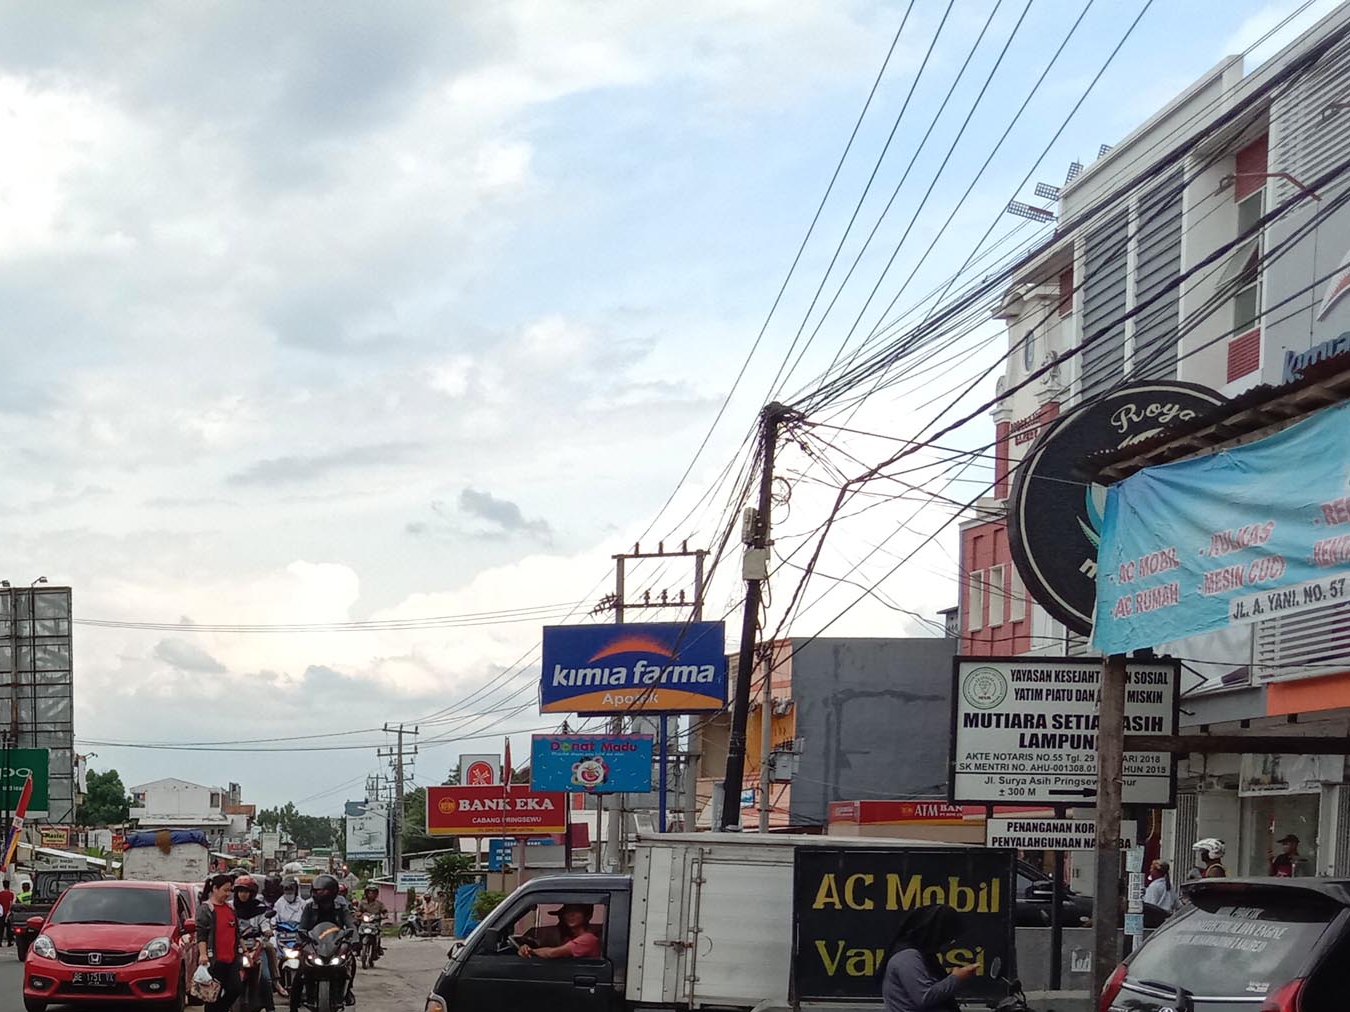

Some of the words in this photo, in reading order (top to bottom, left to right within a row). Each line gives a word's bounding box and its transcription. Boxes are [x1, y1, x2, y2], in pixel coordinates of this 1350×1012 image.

[1203, 565, 1245, 596] MESIN
[1303, 583, 1327, 604] NO.
[552, 664, 627, 687] kimia
[632, 660, 715, 685] farma
[1010, 669, 1052, 683] YAYASAN
[1134, 671, 1169, 685] SOSIAL
[1014, 687, 1044, 702] YATIM
[1045, 688, 1073, 702] PIATU
[1075, 689, 1095, 702] DAN
[1127, 690, 1163, 704] MISKIN
[963, 712, 1048, 729] MUTIARA
[1051, 713, 1100, 731] SETIA
[1122, 715, 1164, 732] ASIH
[600, 741, 638, 752] Madu
[1018, 733, 1099, 751] LAMPUN
[965, 752, 991, 761] AKTE
[992, 752, 1034, 761] NOTARIS
[1084, 754, 1095, 762] 29
[958, 762, 972, 771] SK
[974, 763, 1010, 771] MENTRI
[1012, 763, 1028, 771] NO.
[998, 777, 1027, 788] Surya
[1029, 776, 1051, 785] Asih
[1054, 777, 1098, 788] Pringsew
[1007, 787, 1025, 796] 300
[1027, 788, 1036, 796] M
[458, 798, 512, 811] BANK
[515, 798, 554, 810] EKA
[914, 804, 939, 817] ATM
[940, 804, 963, 812] BAN
[1006, 821, 1073, 834] PENANGANAN
[991, 836, 1082, 848] PENYALAHGUNAAN
[811, 873, 875, 910] AC
[885, 873, 1001, 913] Mobil
